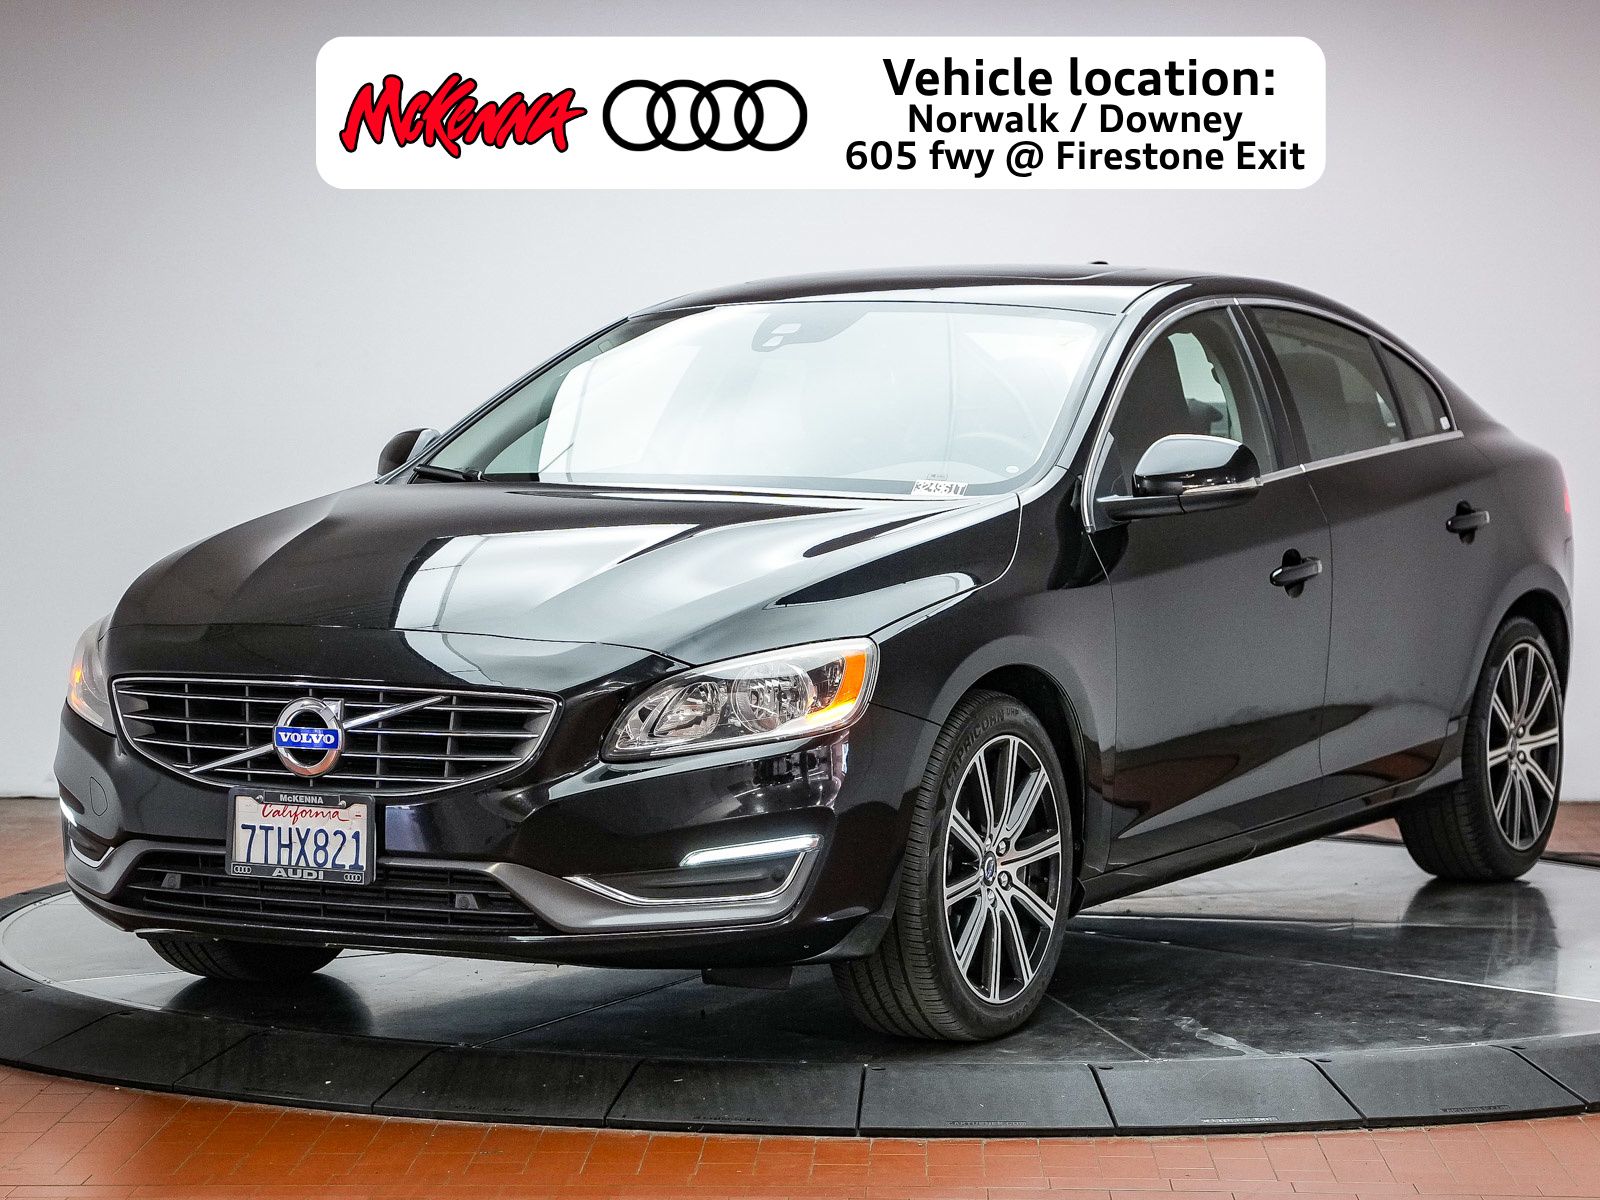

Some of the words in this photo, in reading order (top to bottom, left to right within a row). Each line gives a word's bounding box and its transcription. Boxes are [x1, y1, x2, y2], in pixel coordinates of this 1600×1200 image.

[278, 731, 335, 744] VOLVO
[280, 794, 324, 805] McKENNA
[261, 803, 349, 825] California
[241, 824, 364, 871] 7THX821
[272, 868, 324, 880] AUDI
